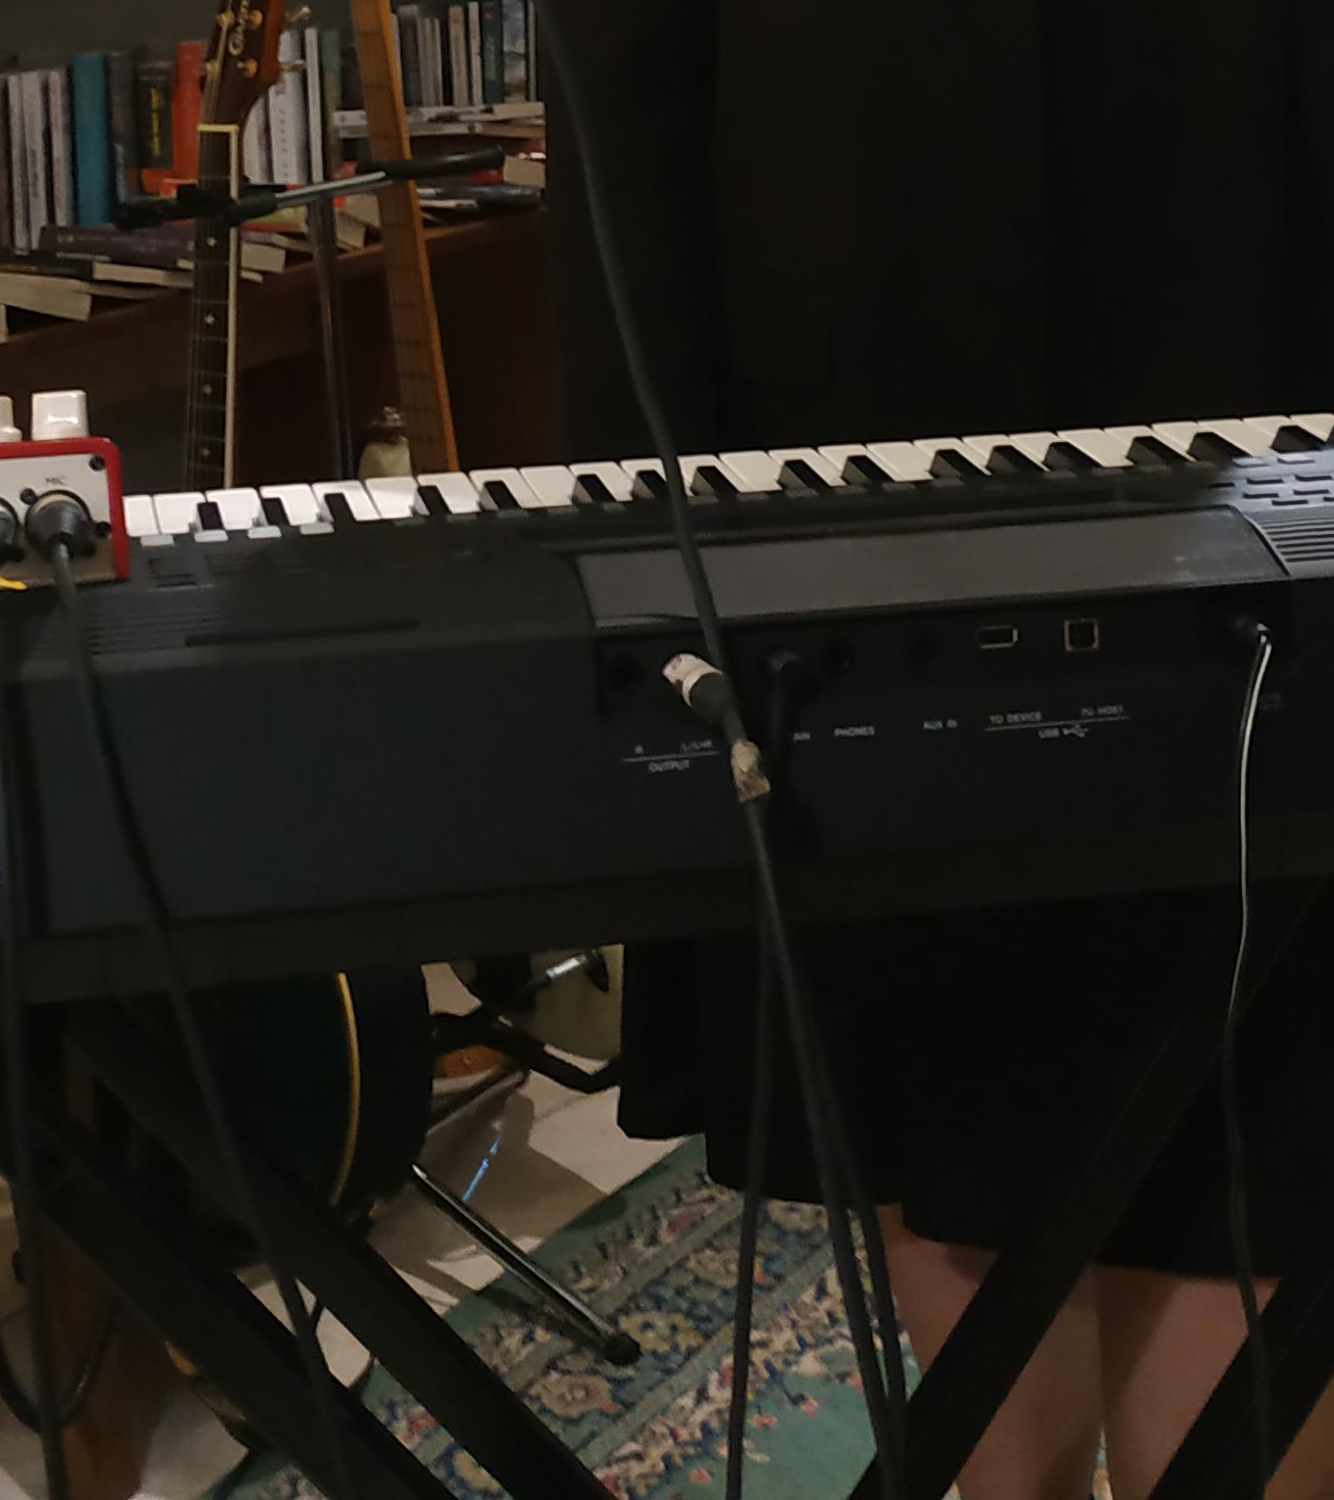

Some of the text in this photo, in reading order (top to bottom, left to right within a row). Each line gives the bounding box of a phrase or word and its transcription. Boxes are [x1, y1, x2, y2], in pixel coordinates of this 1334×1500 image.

[1006, 711, 1042, 723] DEVICE
[834, 725, 875, 738] PHONES
[648, 759, 690, 774] OUTPUT
